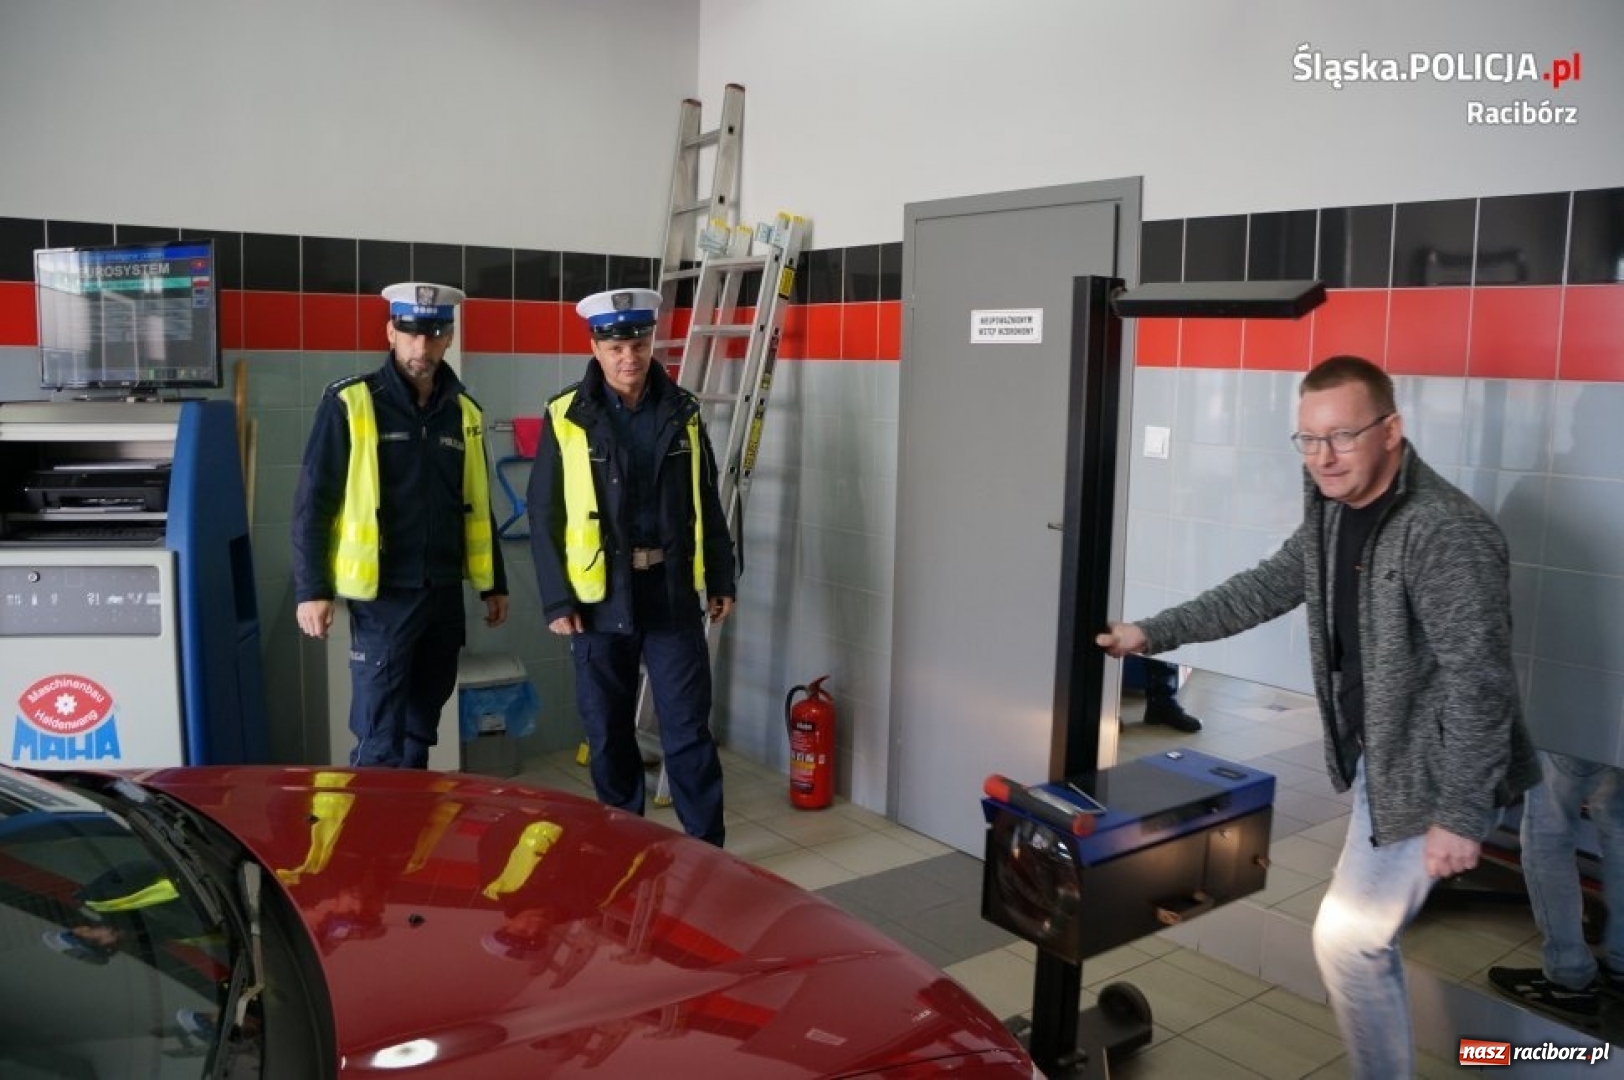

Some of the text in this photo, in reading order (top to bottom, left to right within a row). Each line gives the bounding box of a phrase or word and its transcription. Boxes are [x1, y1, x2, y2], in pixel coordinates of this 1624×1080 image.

[27, 678, 104, 703] Maschinenbau
[35, 711, 98, 730] Haldenwang
[12, 714, 121, 760] MAHA
